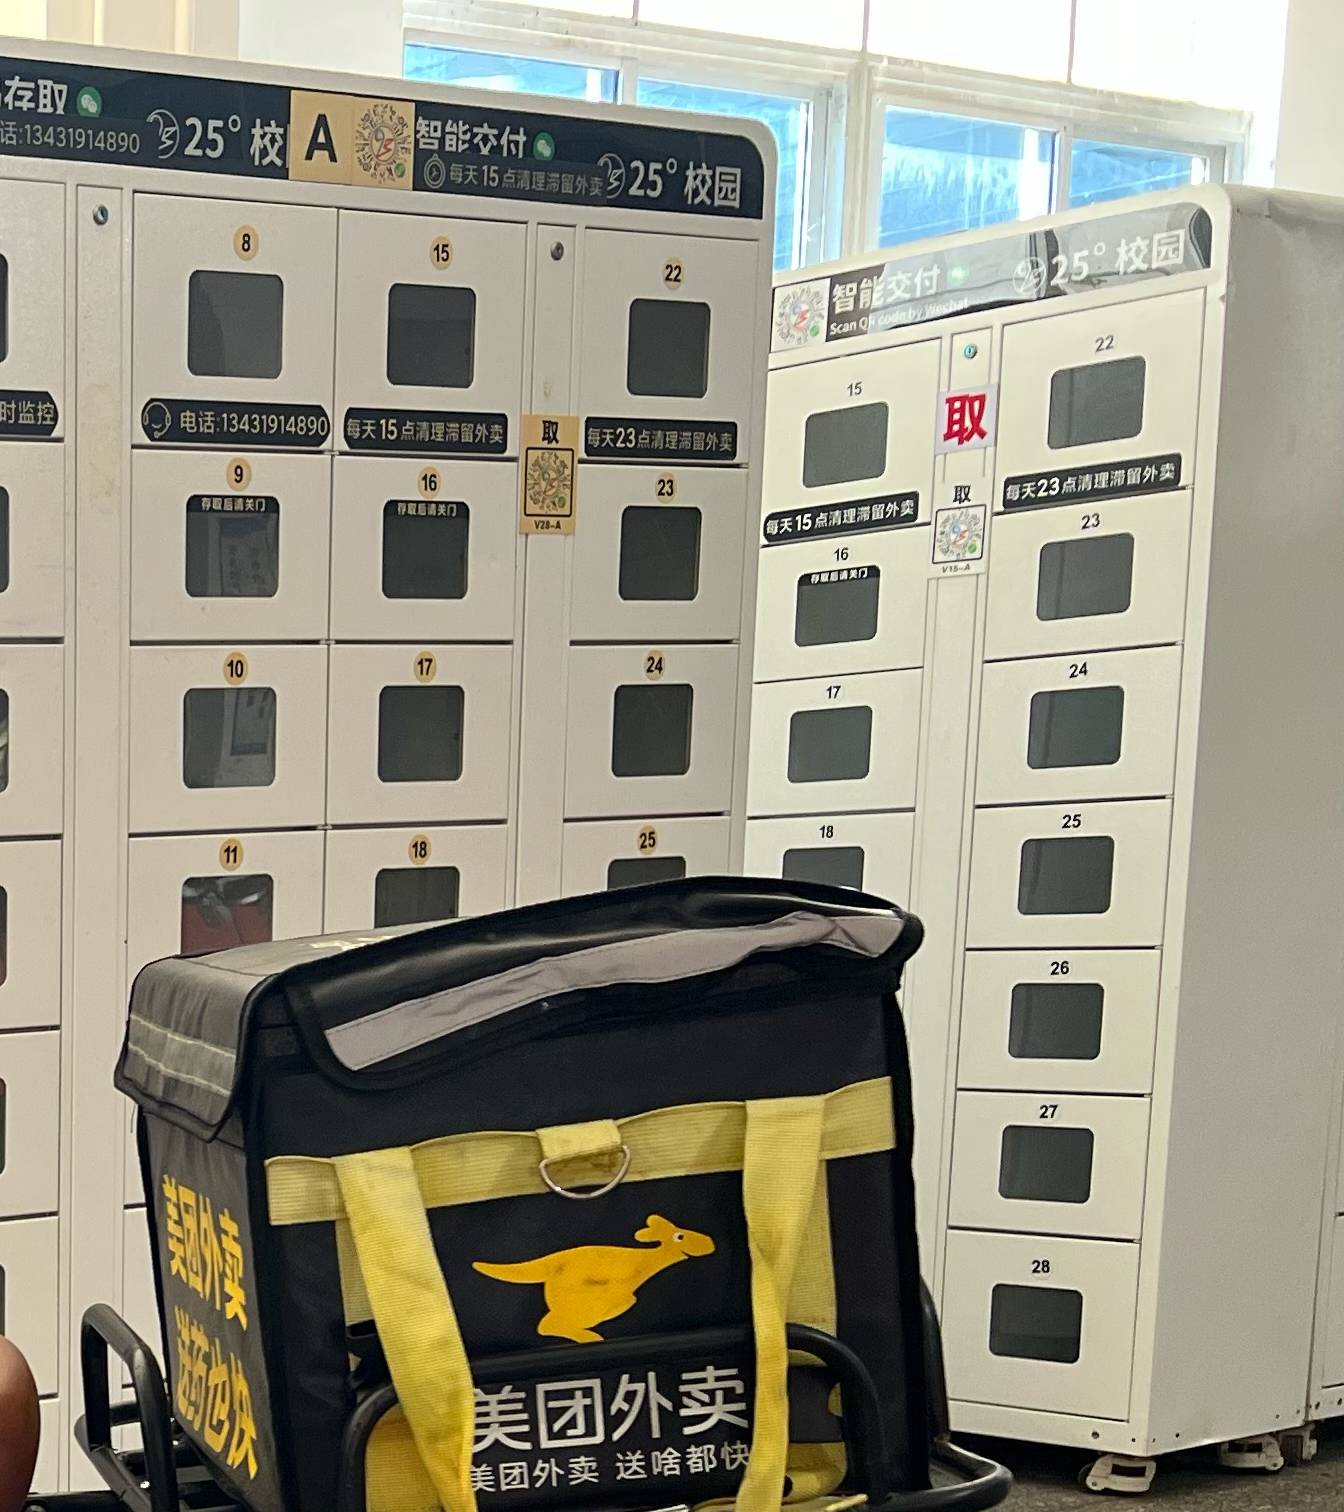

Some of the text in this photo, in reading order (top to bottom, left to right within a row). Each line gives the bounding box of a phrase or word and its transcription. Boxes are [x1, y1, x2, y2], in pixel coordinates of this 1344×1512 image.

[304, 113, 338, 163] A
[416, 116, 527, 159] 智能交付
[684, 161, 741, 209] 校园
[242, 234, 250, 252] 8
[1115, 228, 1185, 276] 校园
[433, 244, 450, 262] 15
[664, 265, 681, 283] 22
[832, 263, 941, 315] 智能交付
[829, 320, 857, 336] Scan
[1095, 336, 1114, 353] 22
[847, 382, 862, 396] 15
[943, 392, 988, 445] 取
[346, 418, 503, 445] 每天15点清理滞留外卖
[542, 420, 559, 444] 取
[587, 426, 732, 453] 每天23点清理滞留外卖
[234, 466, 243, 484] 9
[421, 474, 437, 491] 16
[1006, 462, 1175, 501] 每天23点清理滞留外卖
[658, 479, 673, 496] 23
[953, 485, 971, 504] 取
[765, 502, 914, 536] 每天15点清理滞留外卖
[1081, 513, 1100, 529] 23
[833, 548, 849, 562] 16
[227, 660, 243, 678] 10
[417, 659, 433, 676] 17
[646, 657, 663, 674] 24
[1069, 662, 1088, 679] 24
[826, 686, 841, 700] 17
[1062, 814, 1081, 830] 25
[639, 832, 656, 849] 25
[819, 825, 834, 839] 18
[224, 845, 239, 864] 11
[412, 841, 428, 858] 18
[1050, 960, 1069, 976] 26
[1039, 1104, 1058, 1119] 27
[162, 1173, 248, 1331] 美团外卖
[1031, 1259, 1050, 1275] 28
[472, 1365, 749, 1453] 美团外卖
[470, 1439, 752, 1493] 美团外卖 送啥都快
